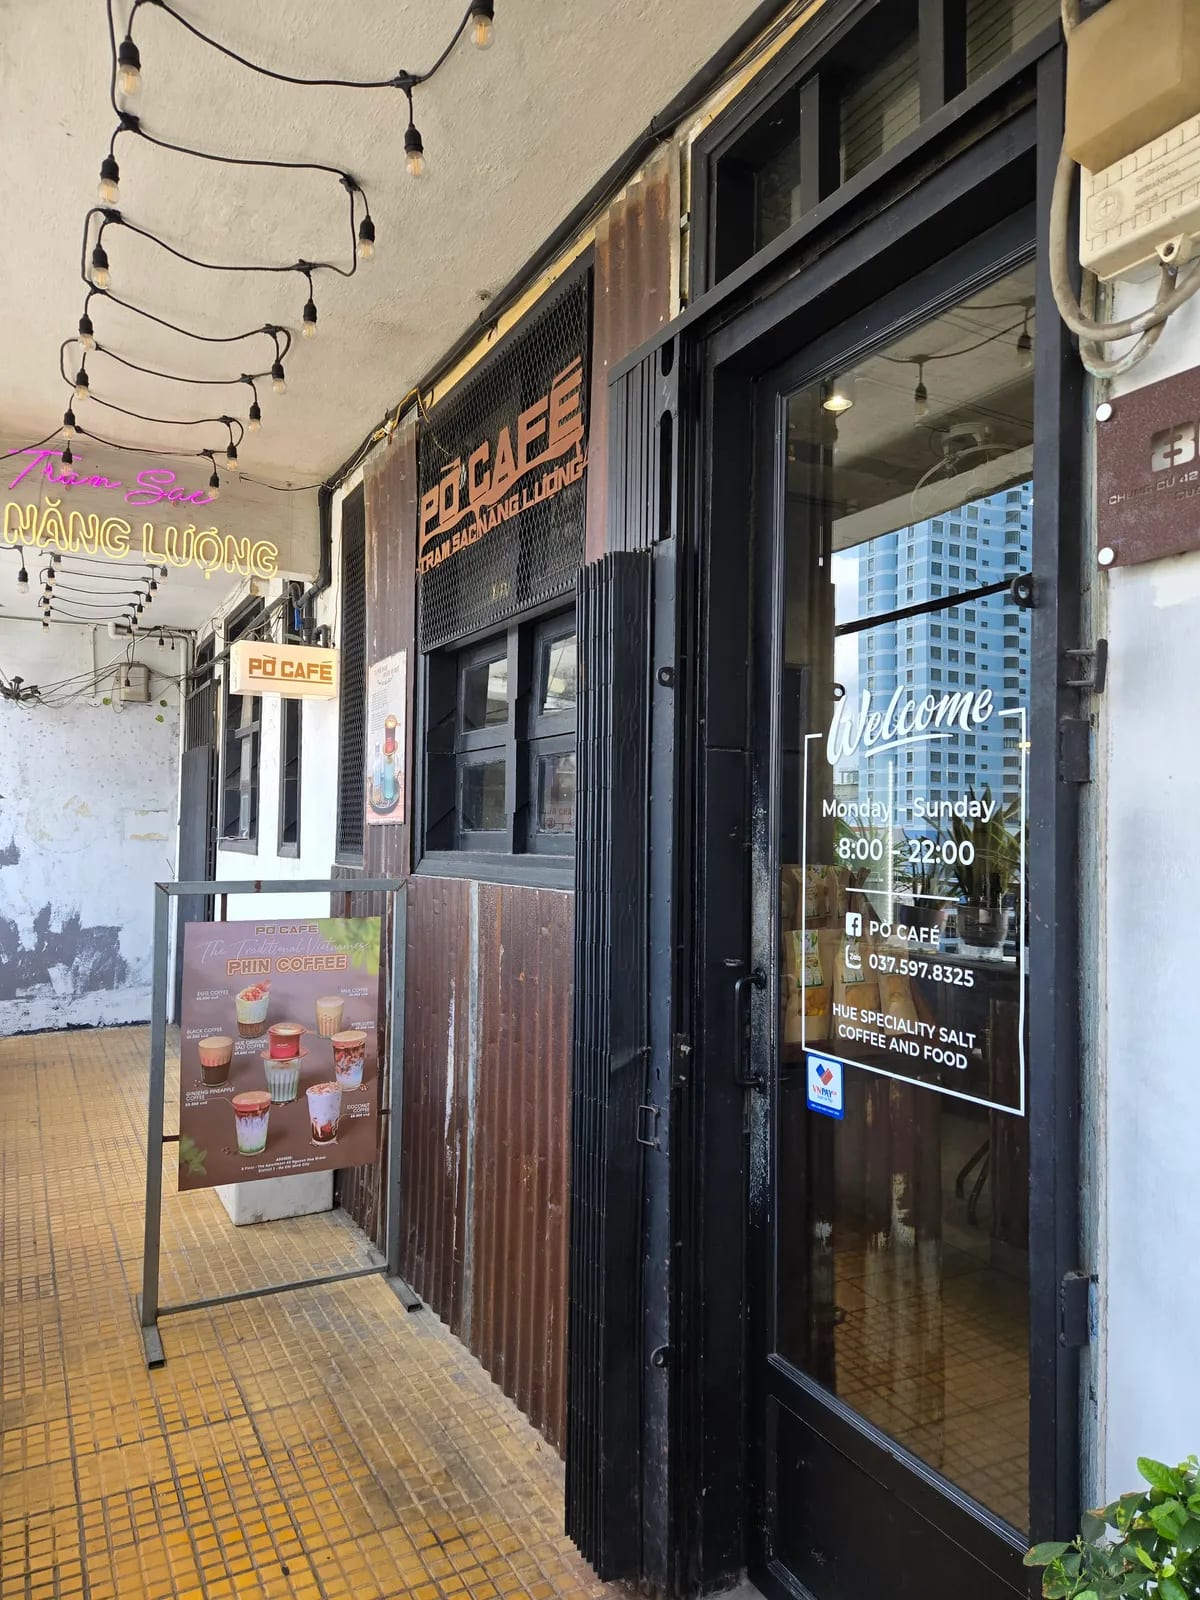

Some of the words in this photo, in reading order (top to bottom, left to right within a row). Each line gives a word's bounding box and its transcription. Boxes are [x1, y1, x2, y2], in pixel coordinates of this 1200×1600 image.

[420, 457, 461, 546] PÒ
[468, 356, 583, 501] CAFÉ
[3, 495, 131, 559] NĂNG
[143, 522, 279, 580] LƯỢNG
[249, 654, 276, 676] PÒ
[281, 661, 332, 681] CAFÉ
[826, 686, 994, 766] Welcome
[822, 799, 893, 822] Monday
[913, 796, 996, 823] Sunday
[838, 838, 883, 861] 8:00
[908, 839, 975, 866] 22:00
[869, 919, 892, 938] PÒ
[897, 925, 940, 945] CAFÉ
[199, 939, 226, 964] The
[227, 958, 272, 976] PHIN
[276, 954, 348, 973] COFFEE
[869, 954, 974, 987] 037.597.8325
[832, 1003, 858, 1021] HUE
[860, 1009, 936, 1040] SPECIALITY
[939, 1026, 976, 1049] SALT
[838, 1024, 887, 1049] COFFEE
[889, 1037, 920, 1057] AND
[923, 1046, 968, 1070] FOOD
